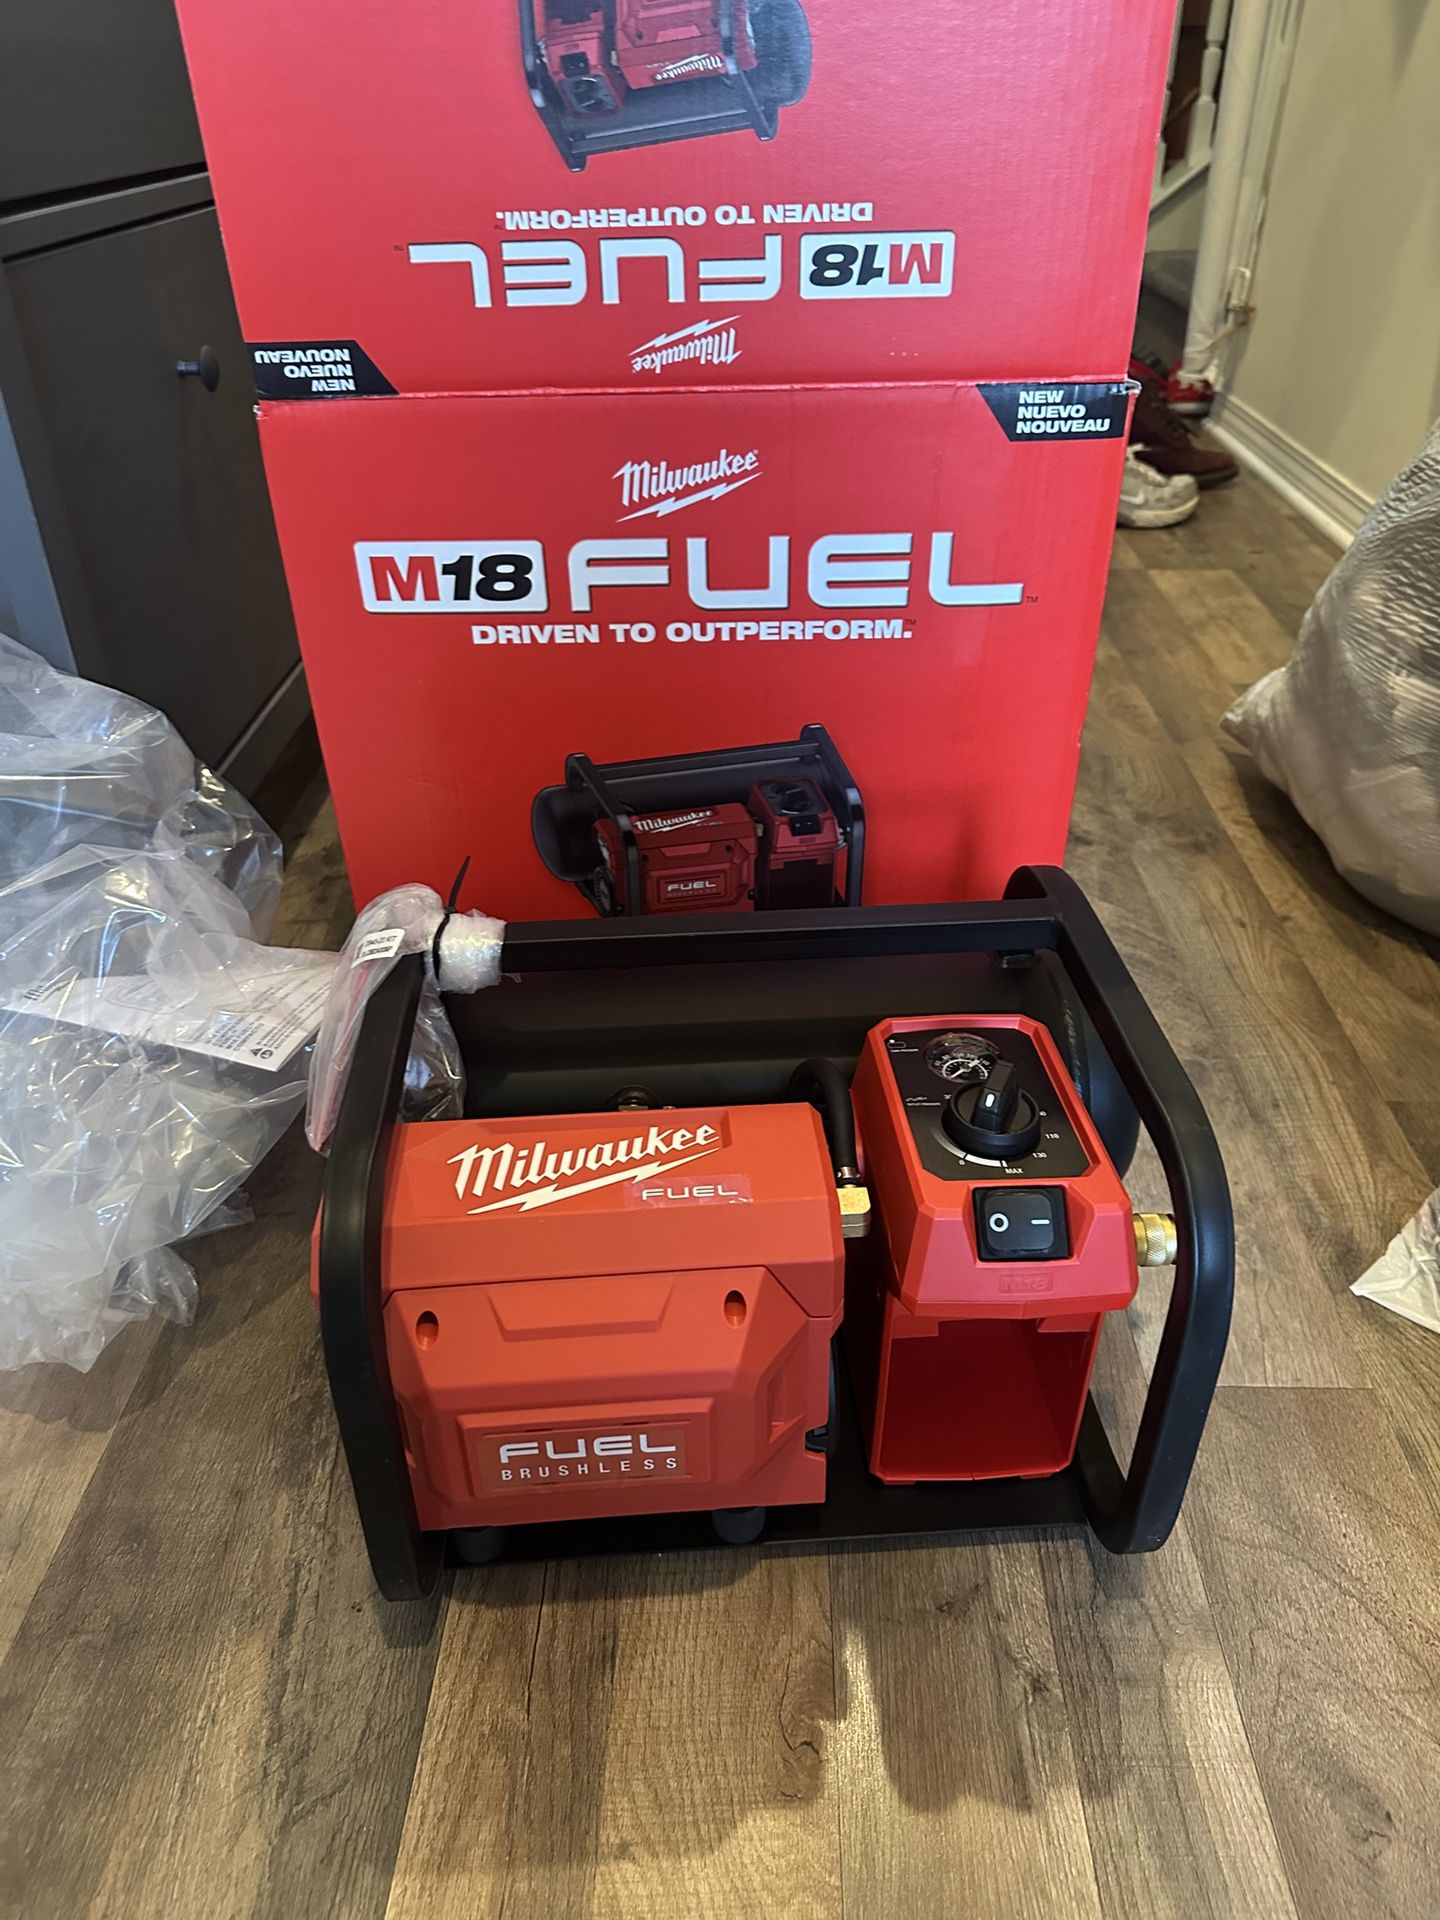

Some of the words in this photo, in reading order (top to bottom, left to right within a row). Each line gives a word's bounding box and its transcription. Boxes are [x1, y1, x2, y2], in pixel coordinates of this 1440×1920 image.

[495, 206, 707, 231] OUTPERFORM.
[714, 205, 756, 225] TO
[763, 202, 873, 224] DRIVEN
[407, 234, 782, 308] FUEL
[809, 242, 944, 287] M18
[254, 348, 351, 364] NOUVEAU
[631, 327, 743, 375] Milwaukee
[283, 364, 353, 378] NUEVO
[311, 378, 356, 392] NEW
[1018, 390, 1064, 404] NEW
[1017, 404, 1087, 419] NUEVO
[1015, 418, 1111, 434] NOUVEAU
[611, 449, 760, 508] Milwaukee
[369, 553, 534, 602] M18
[567, 531, 1024, 613] FUEL
[470, 623, 600, 645] DRIVEN
[608, 622, 656, 643] TO
[665, 618, 913, 642] OUTPERFORM.
[634, 809, 715, 832] Milwaukee
[667, 879, 717, 892] FUEL
[446, 1124, 720, 1200] Milwaukee
[641, 1185, 739, 1201] FUEL
[499, 1433, 677, 1464] FUEL
[501, 1457, 678, 1481] BRUSHLESS
